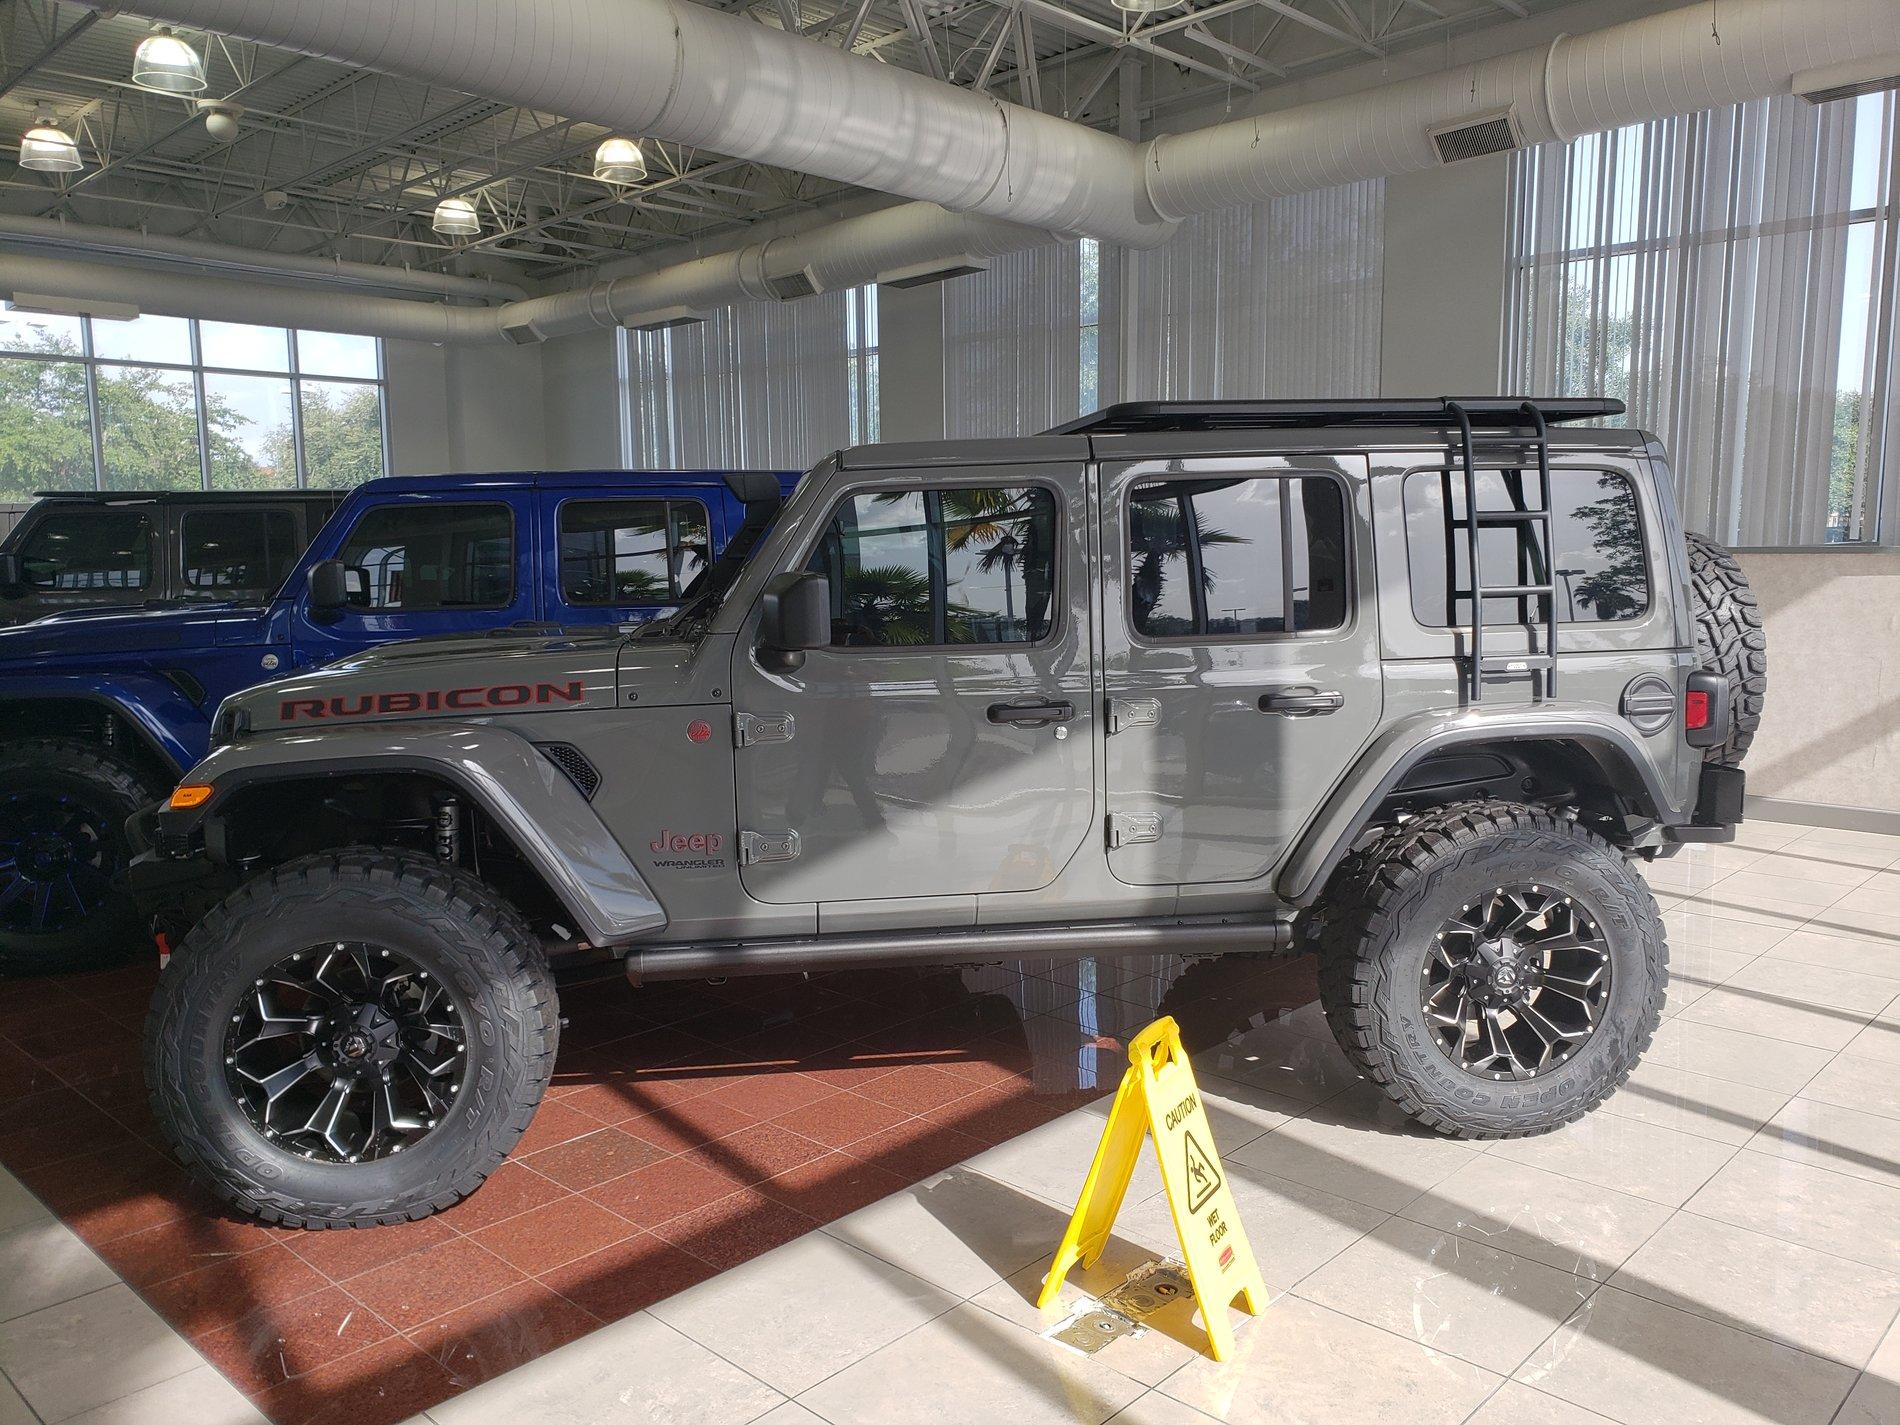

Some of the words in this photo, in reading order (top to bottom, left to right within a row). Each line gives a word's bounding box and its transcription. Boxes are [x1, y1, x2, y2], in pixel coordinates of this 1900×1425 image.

[280, 680, 584, 720] RUBICON
[650, 828, 723, 856] Jeep
[653, 859, 724, 868] WRANGLER
[1400, 1015, 1491, 1106] COUNTRY
[465, 1064, 495, 1130] R/T
[1500, 1077, 1576, 1109] OPEN
[1165, 1093, 1197, 1131] CAUTION
[1207, 1208, 1219, 1227] WET
[1210, 1221, 1228, 1247] FLOOR
